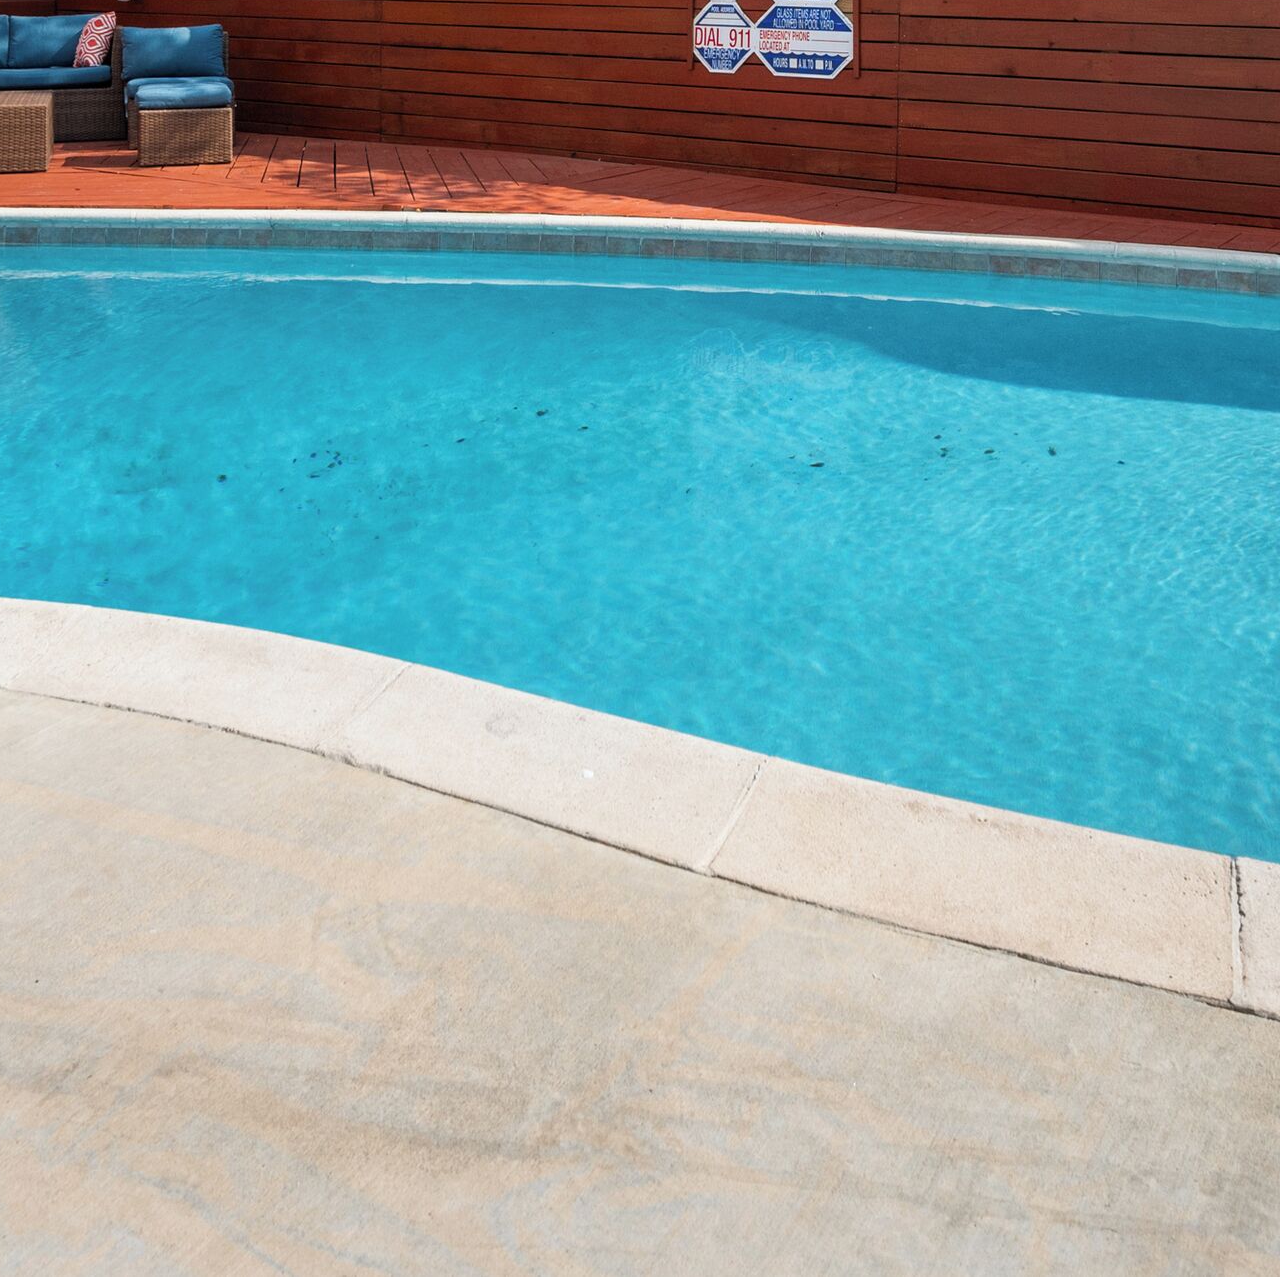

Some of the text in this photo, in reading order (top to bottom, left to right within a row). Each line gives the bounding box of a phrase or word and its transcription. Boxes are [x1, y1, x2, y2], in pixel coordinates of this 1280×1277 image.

[776, 8, 832, 19] GLASS ITEMS ARE NOT
[773, 18, 835, 30] ALLOWED IN POOL YARD
[695, 27, 751, 48] DIAL 911
[760, 30, 811, 42] EMERGENCY PHONE
[759, 40, 790, 51] LOCATED AT
[703, 48, 741, 60] EMERGENCY
[711, 59, 733, 71] NUMBER
[773, 58, 789, 68] HOURS
